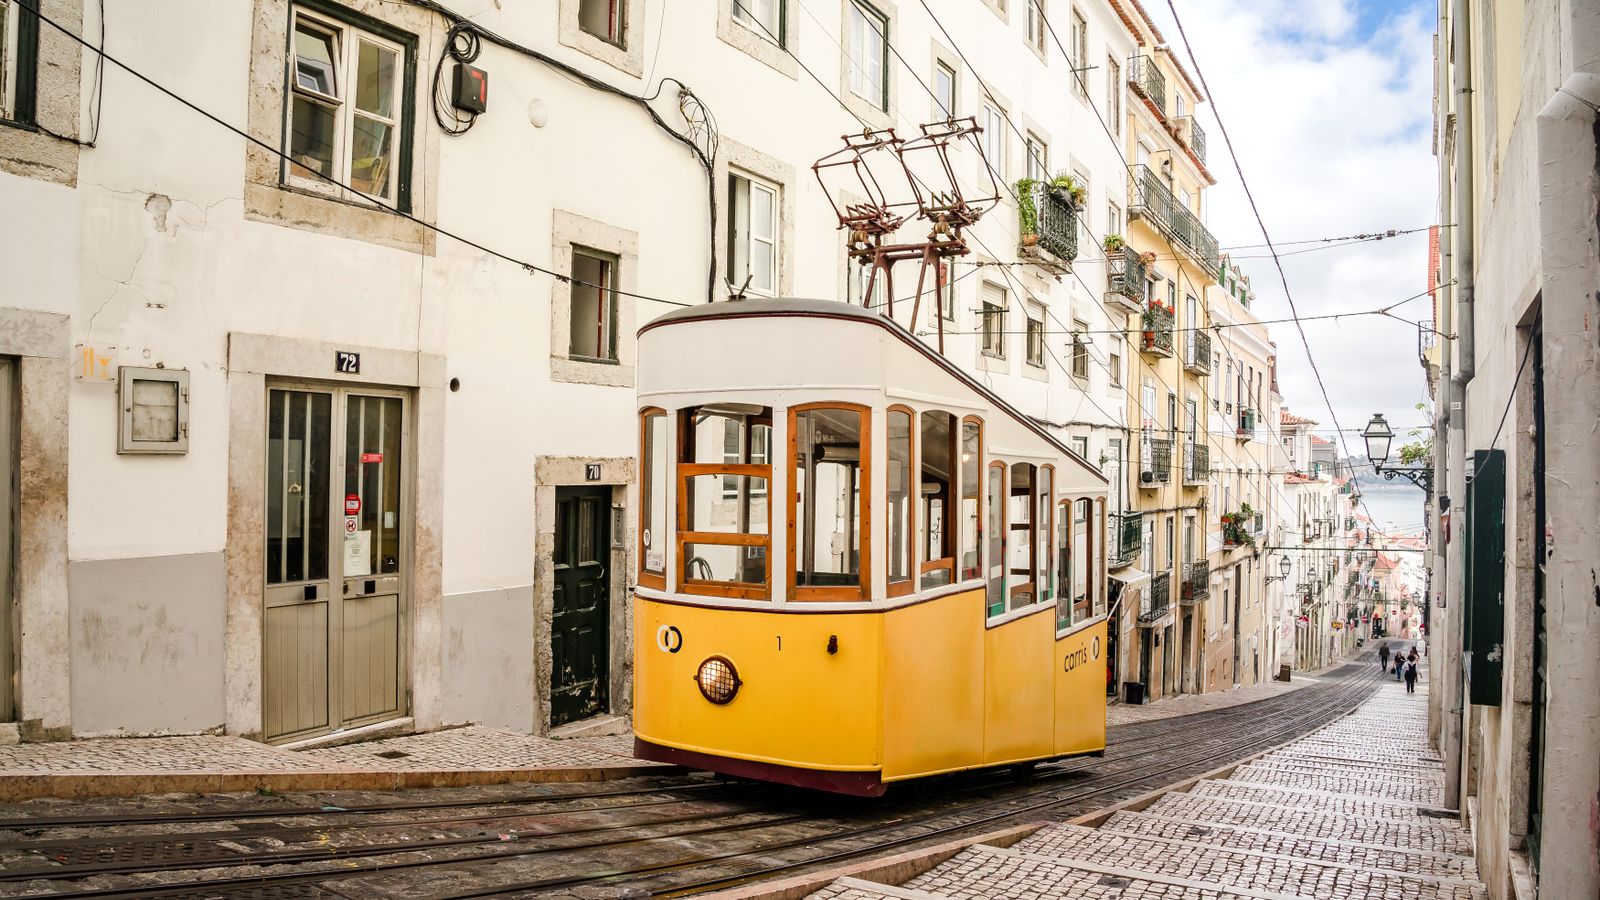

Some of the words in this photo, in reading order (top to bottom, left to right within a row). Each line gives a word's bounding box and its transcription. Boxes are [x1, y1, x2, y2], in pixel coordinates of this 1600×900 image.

[340, 353, 357, 372] 72
[589, 465, 599, 480] 70
[776, 635, 782, 651] 1
[1064, 641, 1087, 673] carris
